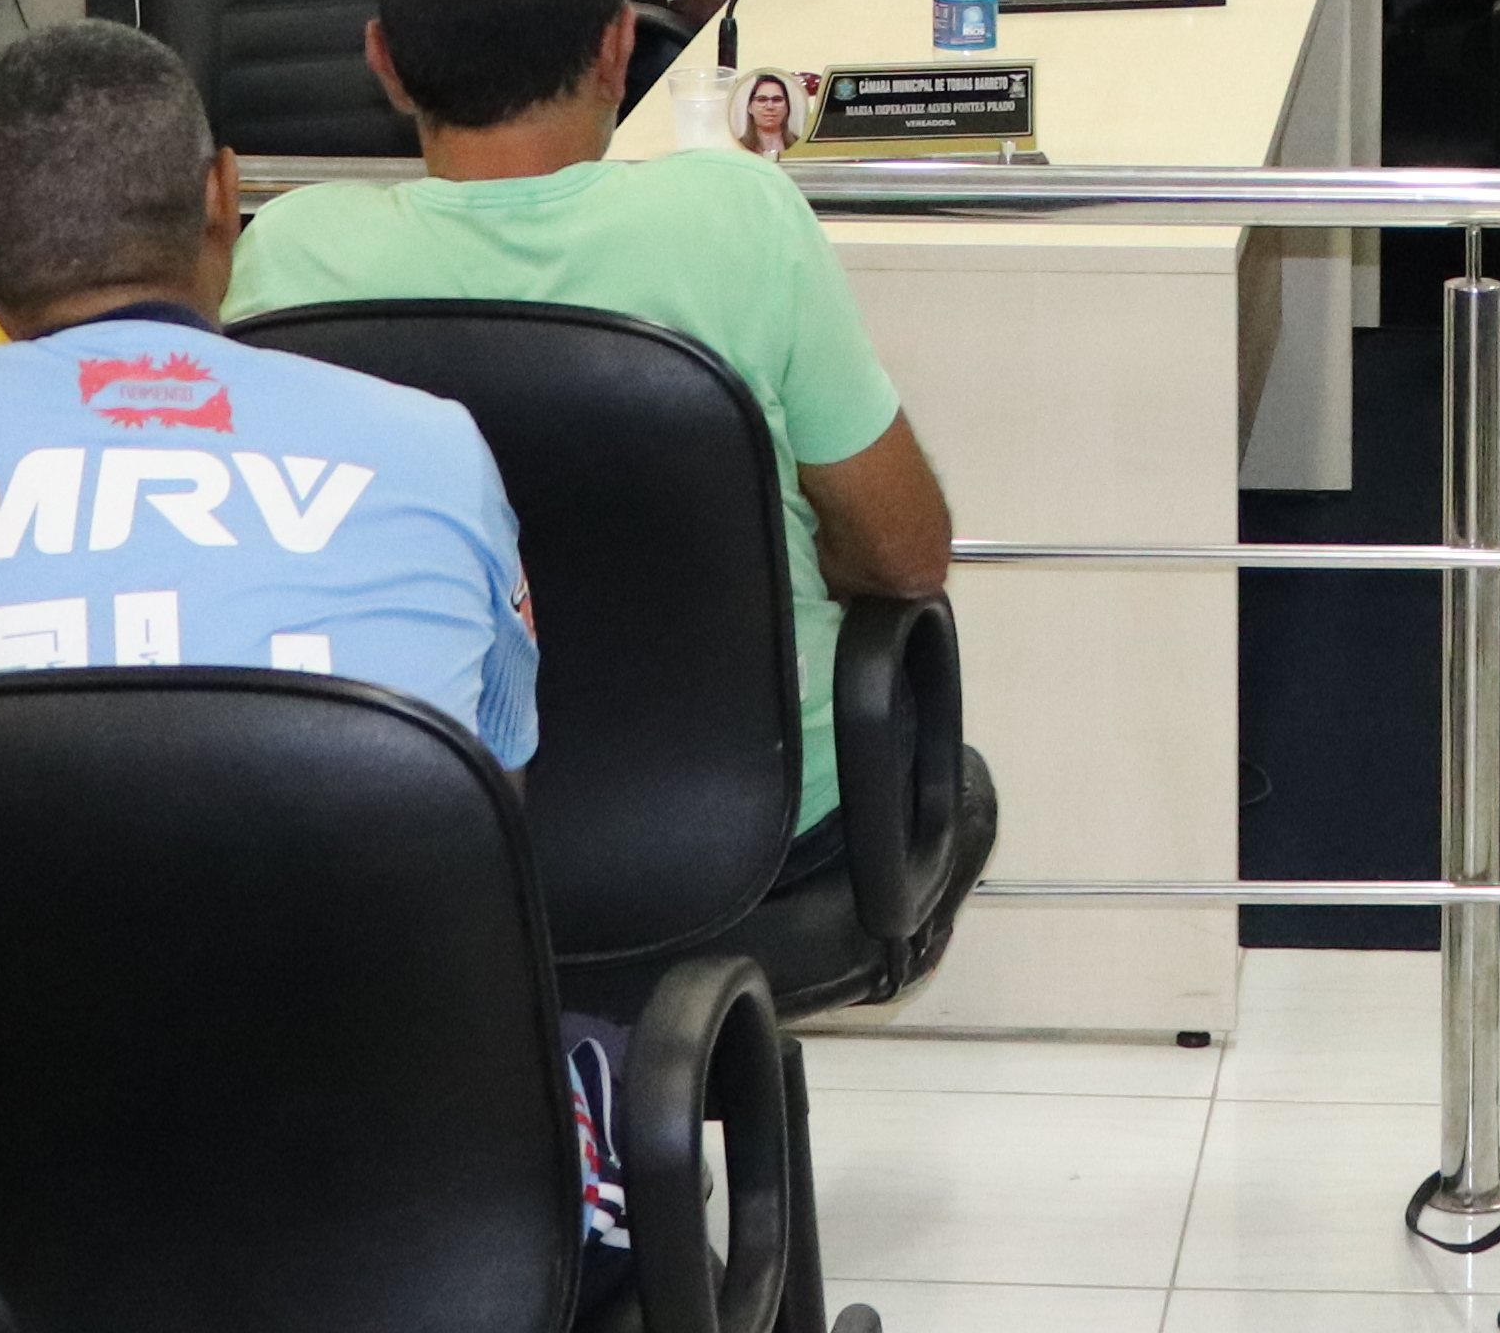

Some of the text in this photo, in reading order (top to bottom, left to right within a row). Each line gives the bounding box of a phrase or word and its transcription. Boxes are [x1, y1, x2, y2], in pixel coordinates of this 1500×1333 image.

[859, 76, 1009, 94] CÂMARA MUNICIPAL DE TOBIAS BARRETO
[845, 105, 873, 116] MARIA
[926, 102, 951, 114] ALVES
[953, 101, 986, 113] FONTES
[986, 100, 1016, 112] PRADO
